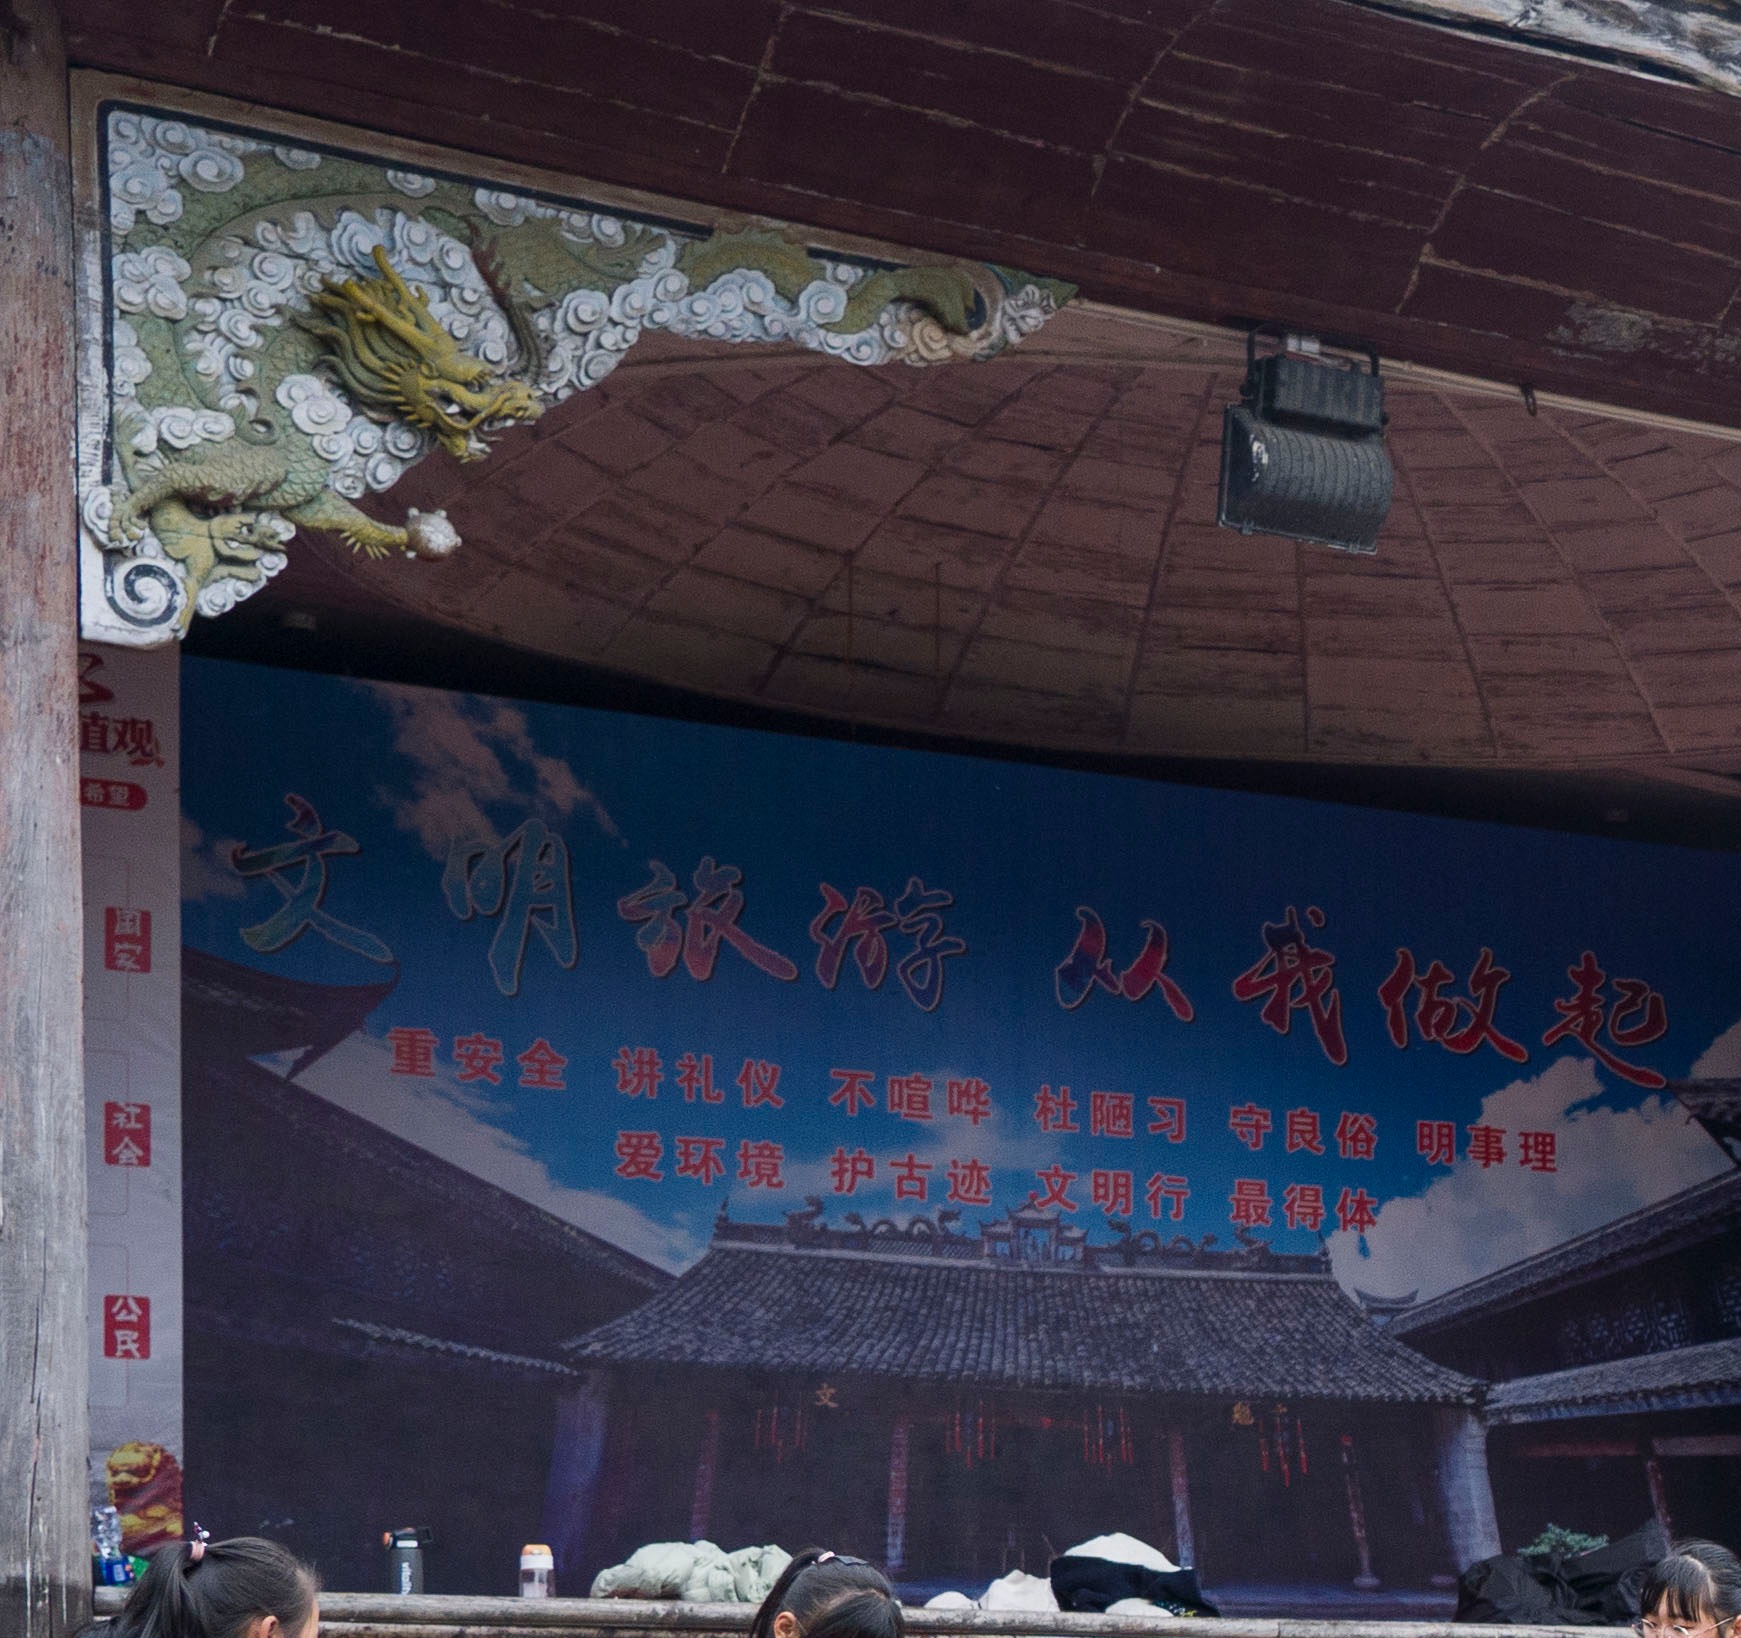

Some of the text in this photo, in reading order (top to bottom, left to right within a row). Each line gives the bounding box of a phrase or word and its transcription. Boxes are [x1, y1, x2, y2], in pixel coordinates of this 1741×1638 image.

[232, 793, 1671, 1089] 文明旅游 从我做起
[112, 1100, 145, 1166] 社会
[387, 1027, 1559, 1174] 重安全 讲礼仪 不喧哗 杜陋习 守良俗 明事理
[613, 1130, 1381, 1235] 爱环境 护古迹 文明行 最得体
[111, 1294, 144, 1358] 公民
